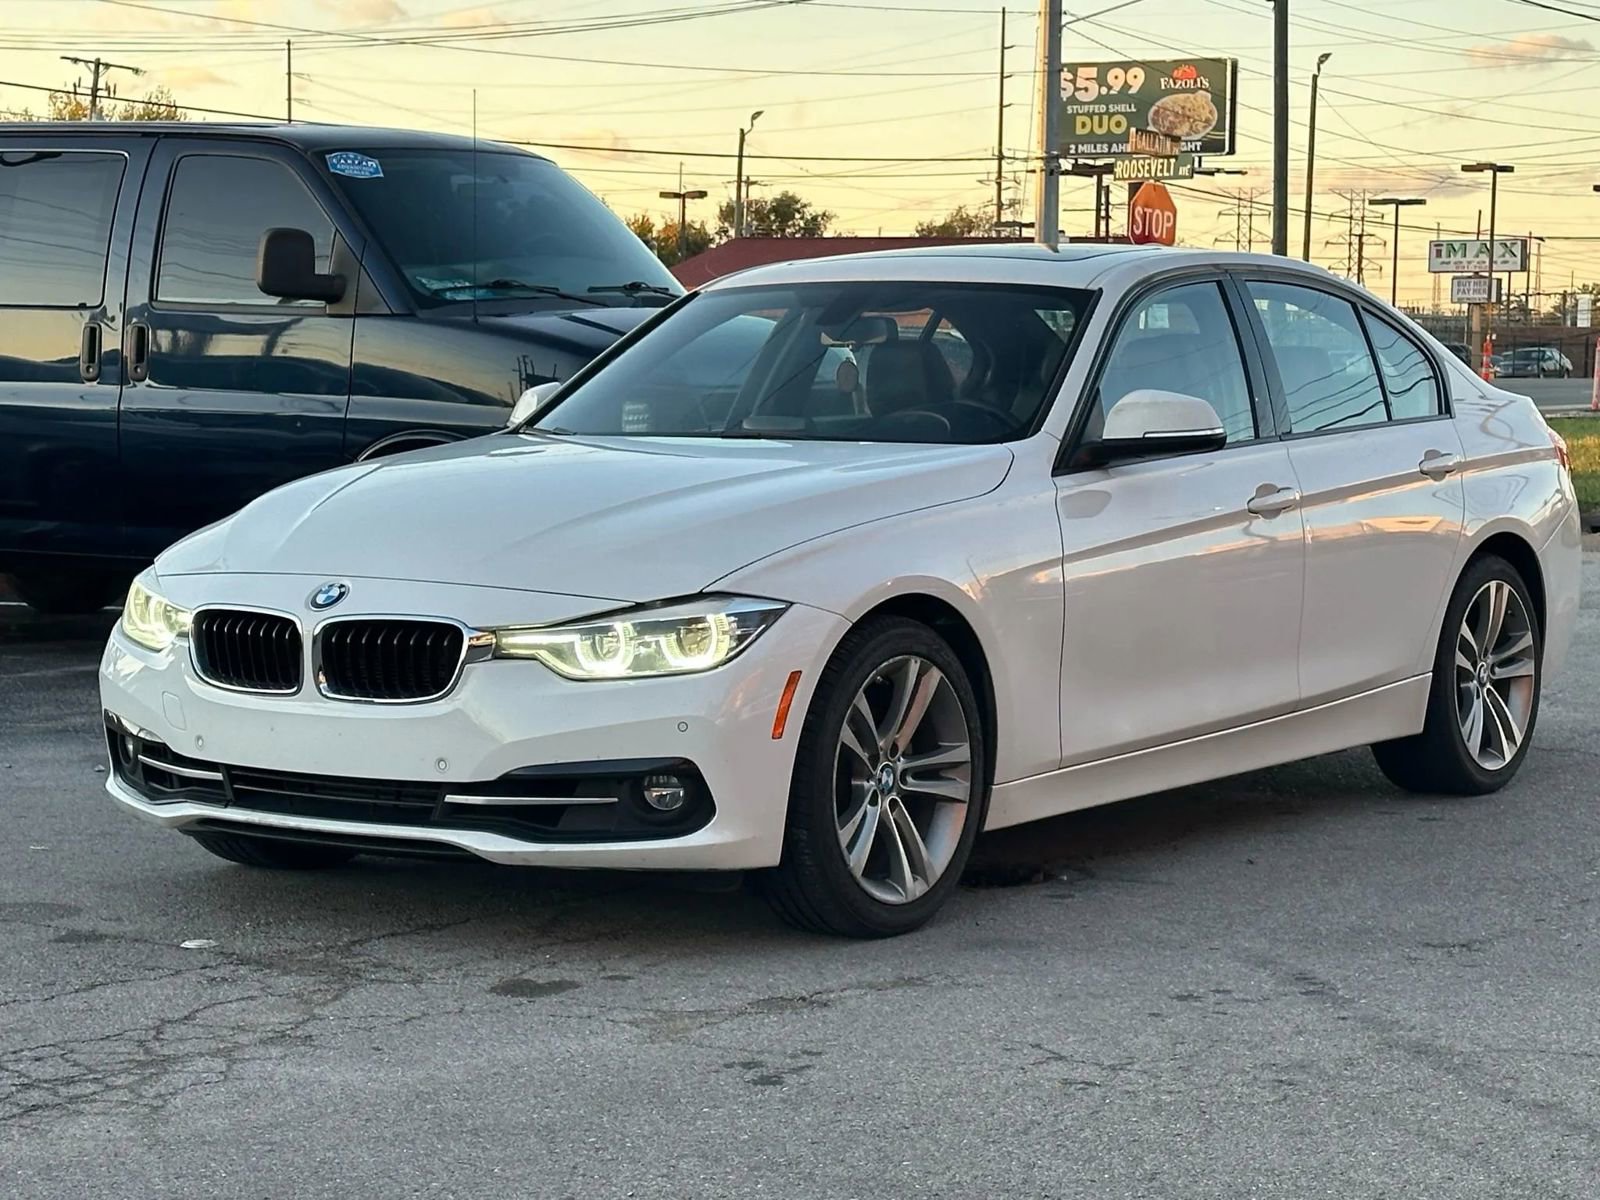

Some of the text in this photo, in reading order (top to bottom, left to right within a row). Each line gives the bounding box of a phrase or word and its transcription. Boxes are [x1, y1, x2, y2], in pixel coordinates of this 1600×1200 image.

[1061, 67, 1145, 102] $5.99
[1066, 103, 1137, 114] STUFFED SHELL
[1075, 114, 1128, 135] DUO
[1069, 144, 1076, 154] 2
[1078, 143, 1109, 153] MILES
[1180, 141, 1202, 152] GHT
[1115, 158, 1176, 178] ROOSEVELT
[1133, 206, 1174, 239] STOP
[1456, 280, 1488, 288] BUY HER
[1456, 287, 1488, 296] PAY HER
